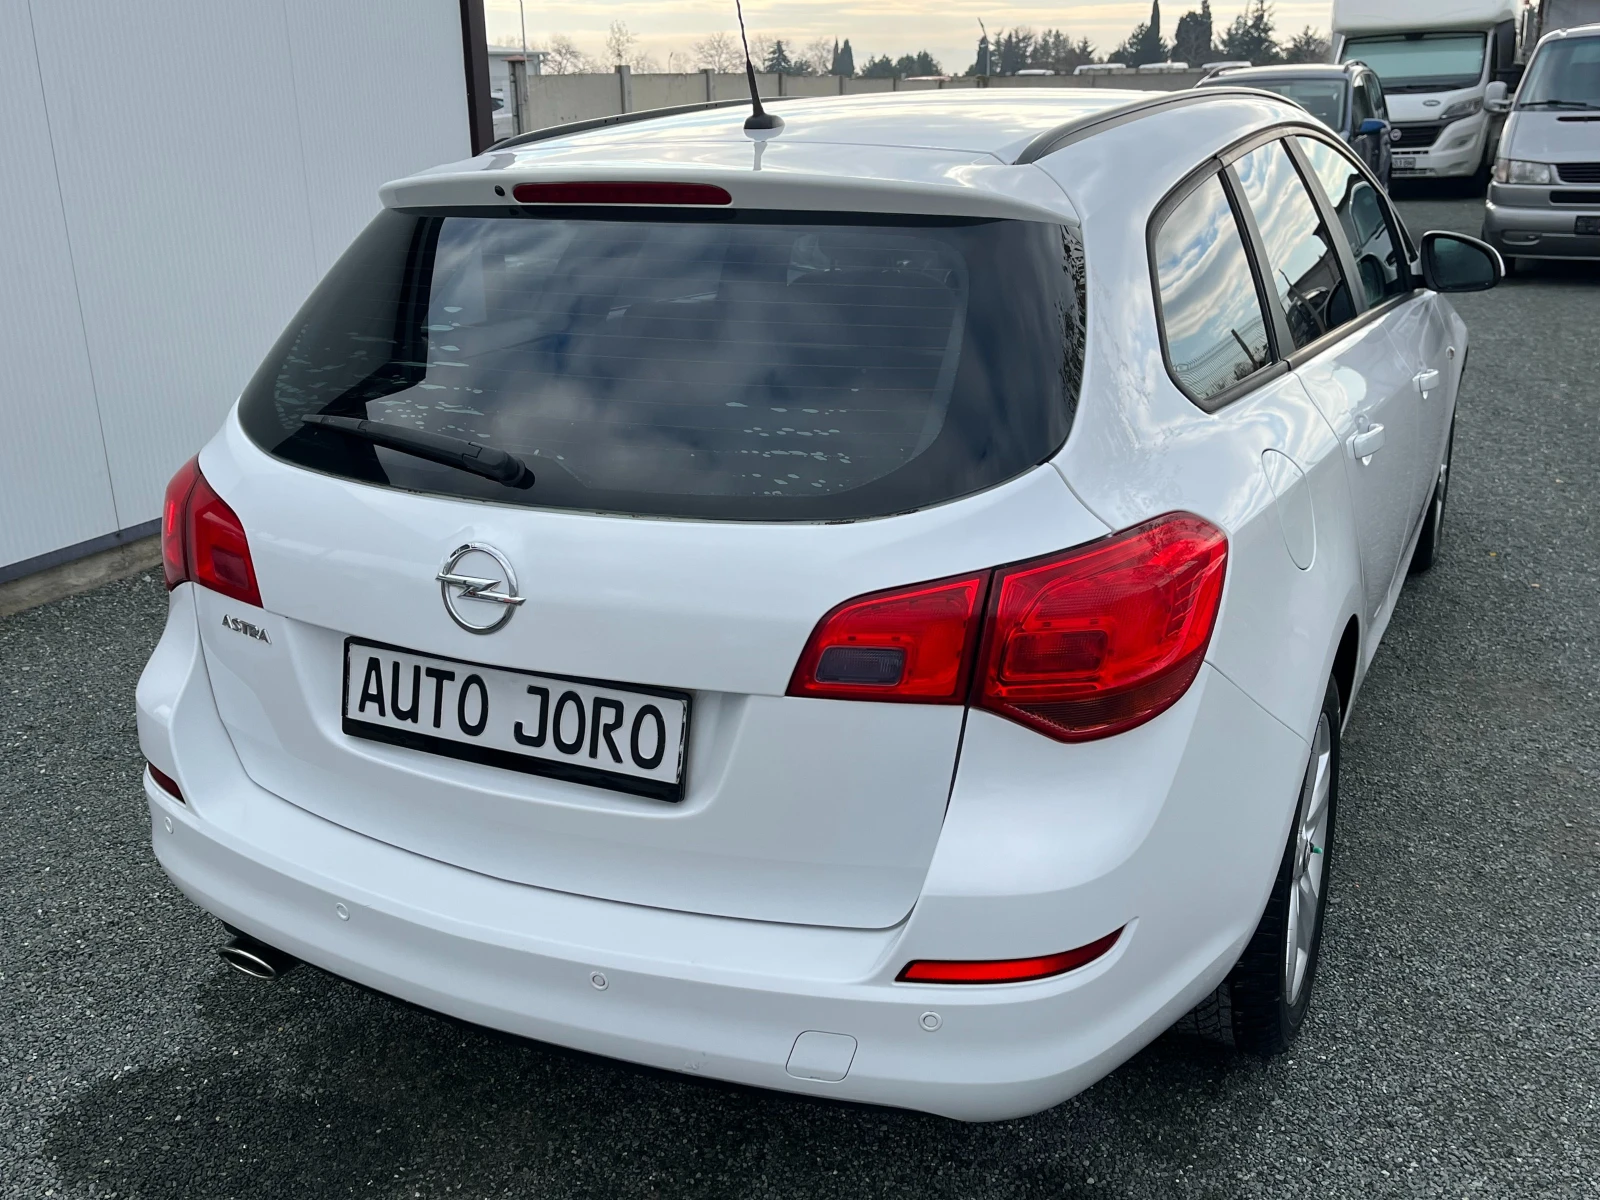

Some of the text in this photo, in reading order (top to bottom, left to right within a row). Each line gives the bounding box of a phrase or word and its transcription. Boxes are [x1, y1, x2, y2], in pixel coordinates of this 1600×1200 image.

[222, 614, 272, 645] ASTRA
[358, 656, 666, 770] AUTO JORO
